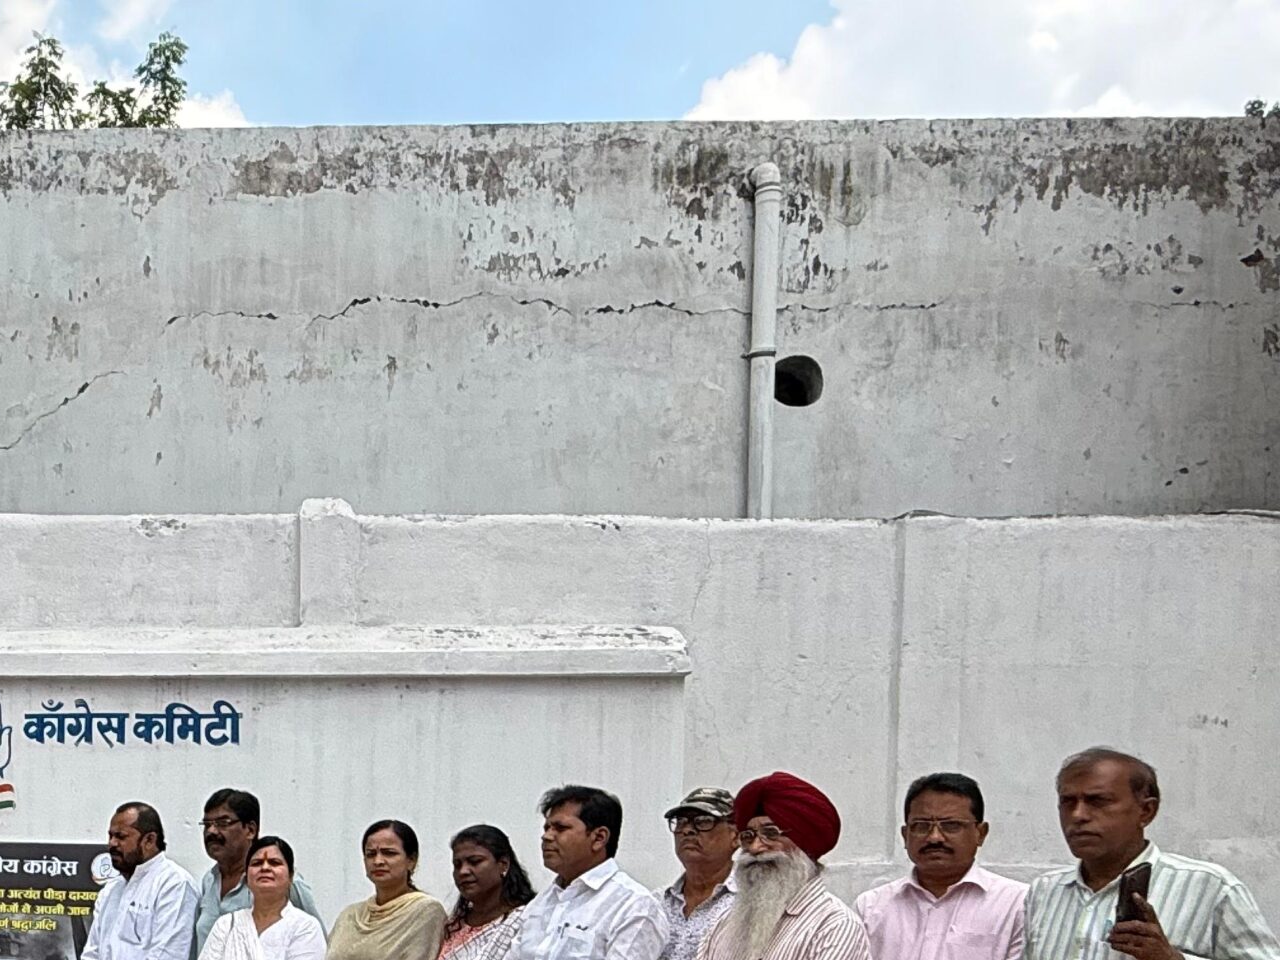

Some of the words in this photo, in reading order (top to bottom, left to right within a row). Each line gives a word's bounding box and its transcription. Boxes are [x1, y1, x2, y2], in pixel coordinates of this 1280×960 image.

[133, 700, 243, 747] कमिटी
[23, 855, 79, 877] कांग्रेस
[7, 888, 41, 900] अत्यंत
[21, 903, 31, 914] ने
[34, 904, 65, 915] अपनी
[67, 906, 91, 916] जान
